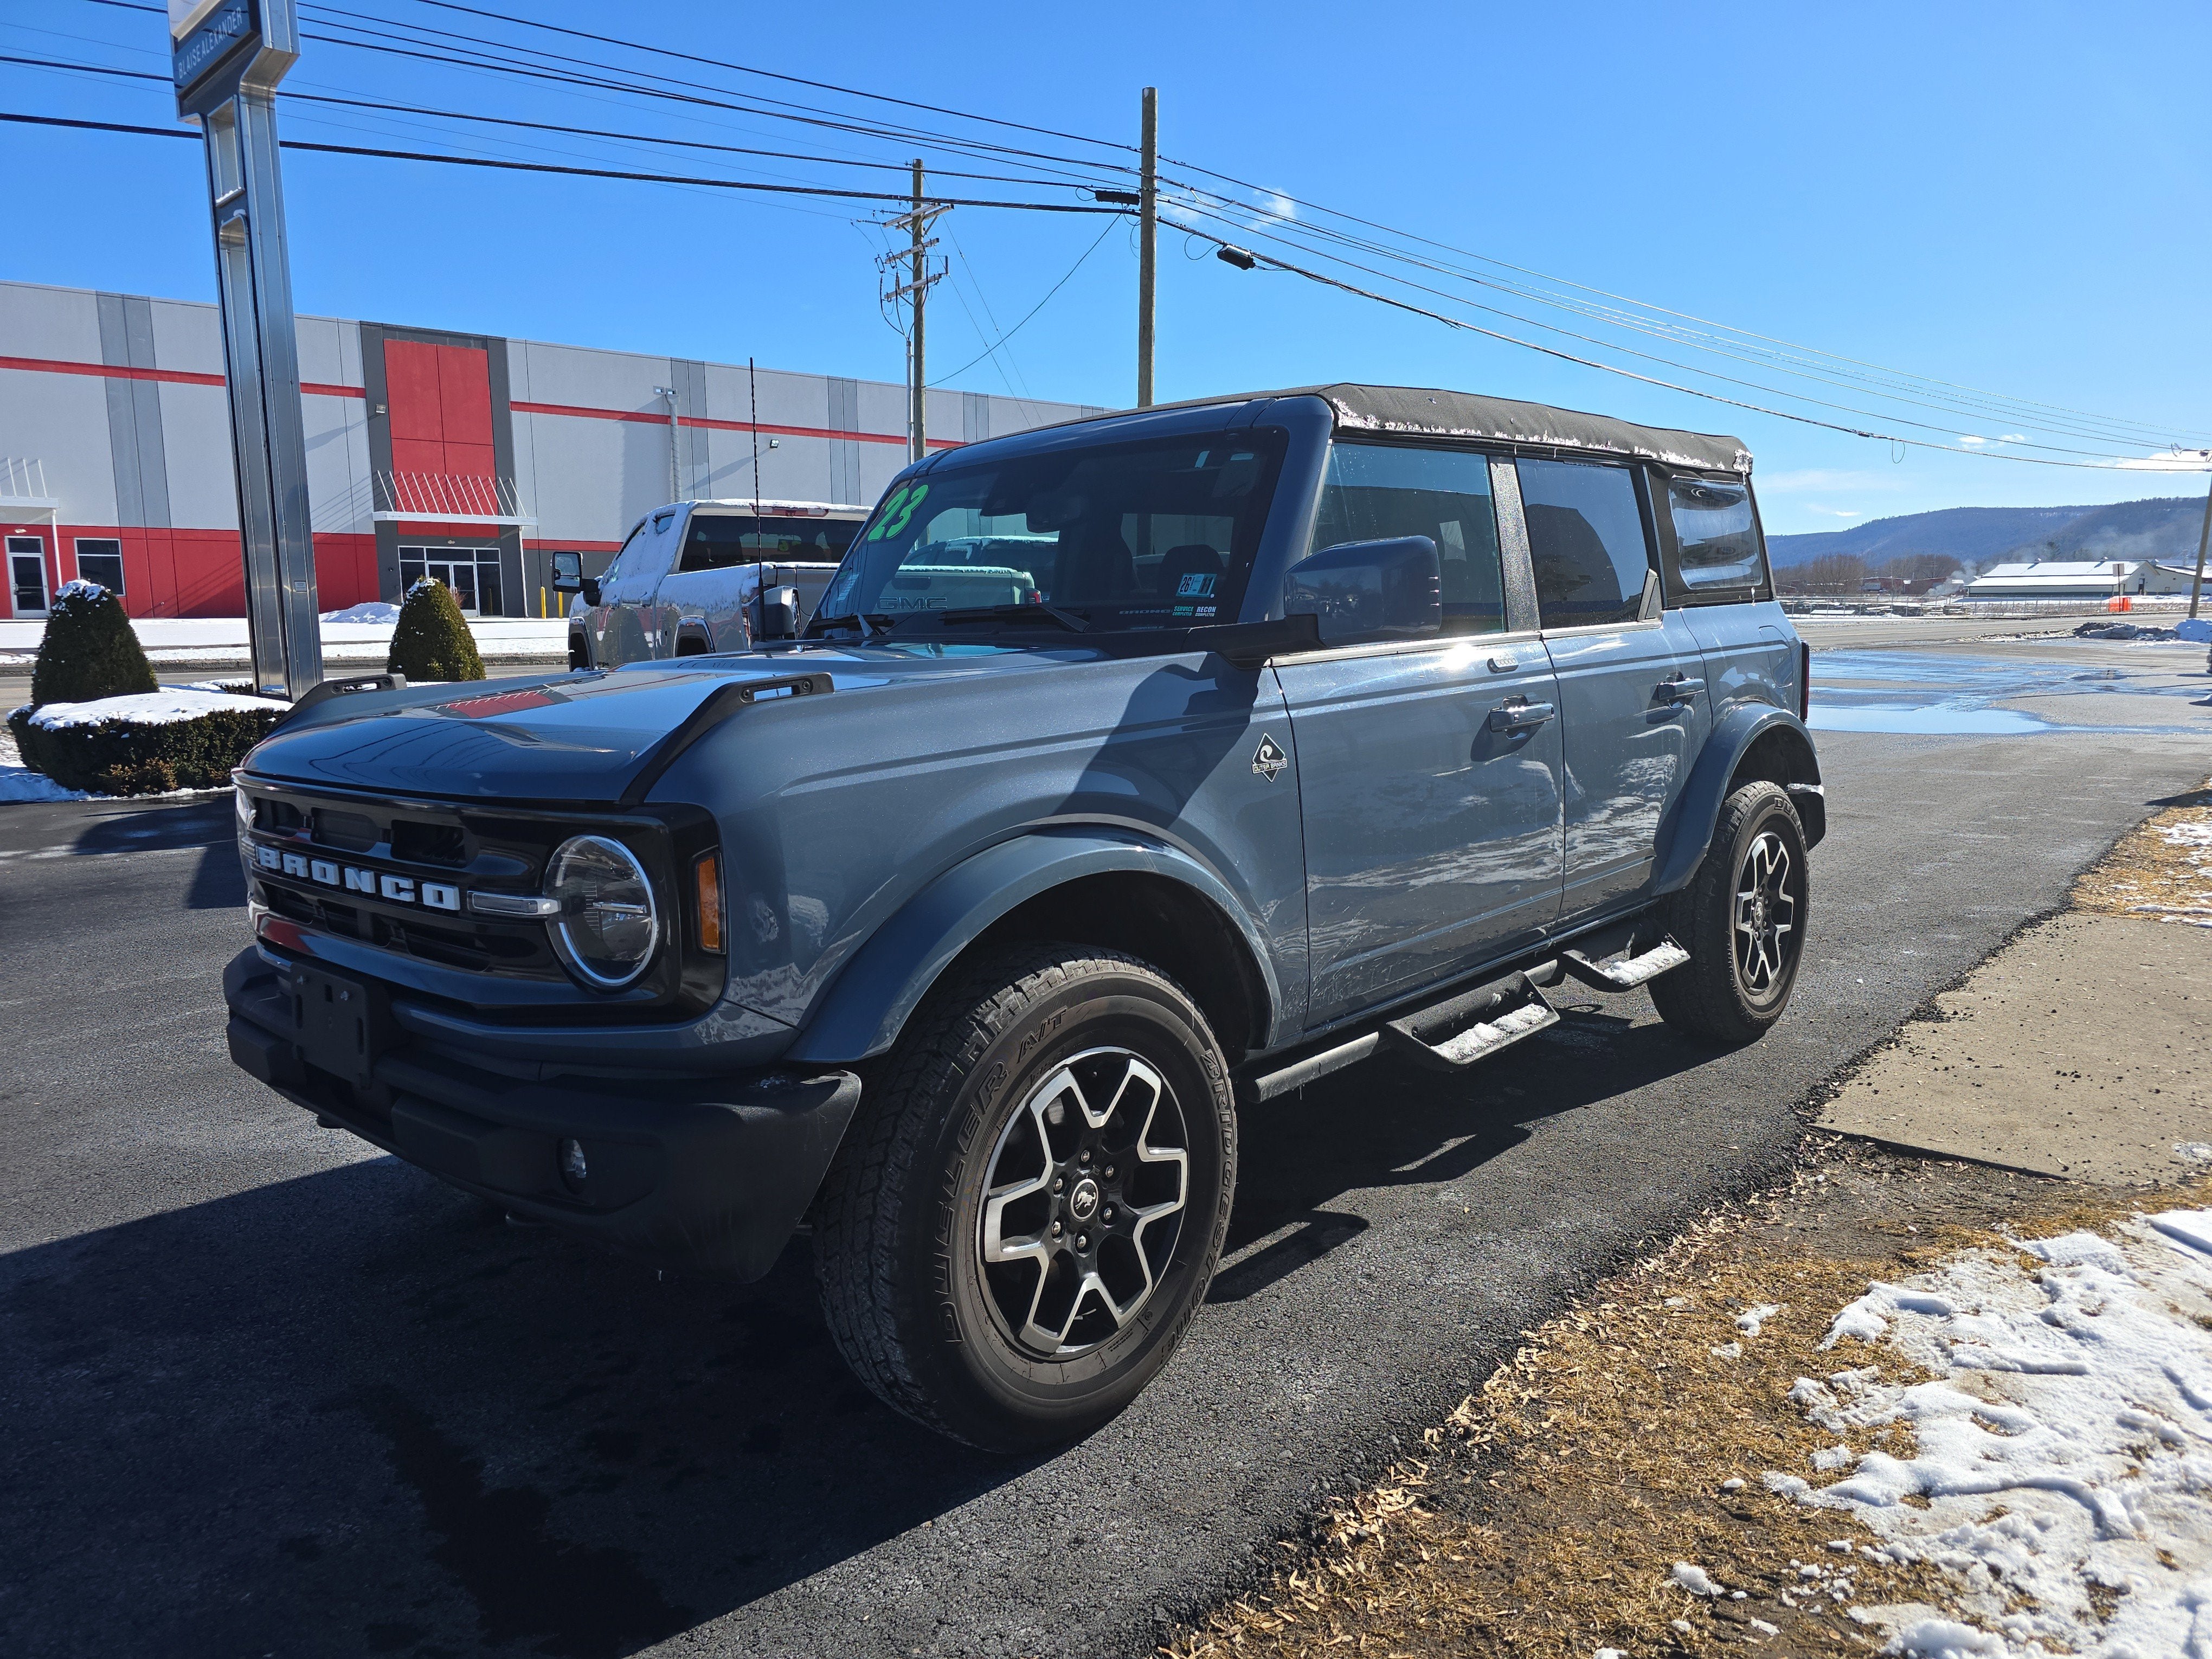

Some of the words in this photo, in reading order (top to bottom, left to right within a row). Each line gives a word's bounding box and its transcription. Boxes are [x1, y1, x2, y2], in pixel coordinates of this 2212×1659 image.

[178, 44, 201, 79] BLAISE
[201, 6, 243, 59] ALEXANDER
[867, 484, 929, 542] 23
[877, 597, 948, 609] GMC
[1270, 761, 1286, 769] BANKS
[256, 844, 461, 911] BRONCO
[933, 1059, 1010, 1343] DUELER
[1017, 1005, 1068, 1064] A/T
[1160, 1048, 1234, 1366] BRIDGESTONE
